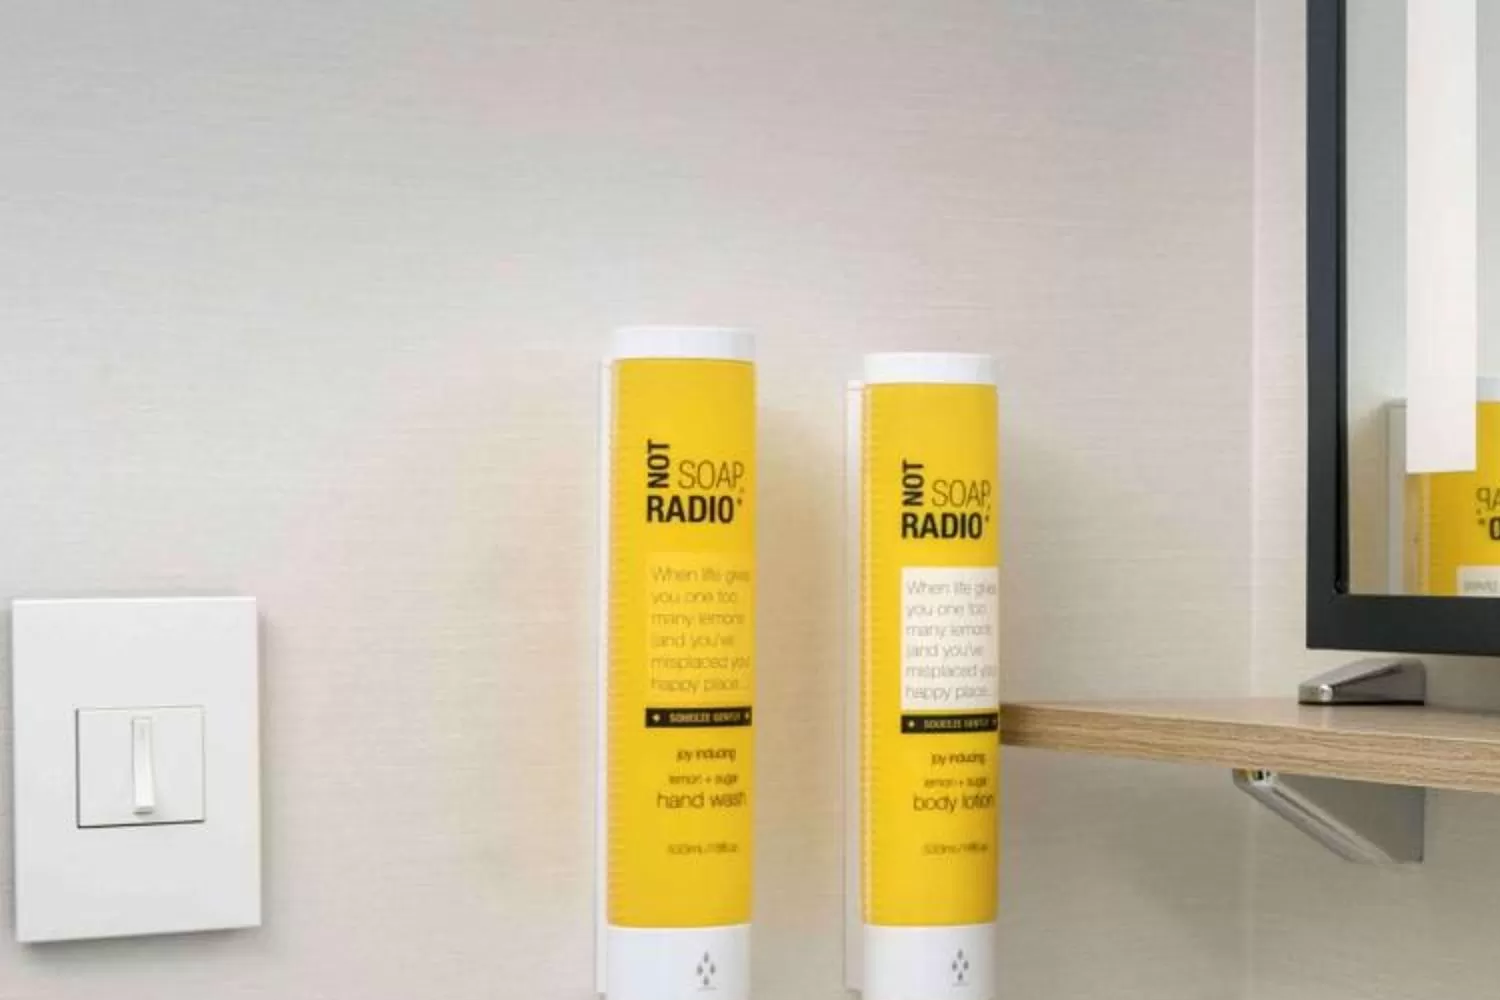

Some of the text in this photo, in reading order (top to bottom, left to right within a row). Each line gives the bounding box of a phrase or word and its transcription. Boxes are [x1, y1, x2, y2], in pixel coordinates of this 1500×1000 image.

[647, 438, 670, 489] NOT
[902, 457, 924, 507] NOT
[651, 566, 698, 583] When
[905, 580, 948, 597] When
[651, 592, 681, 607] you
[685, 592, 714, 605] one
[905, 604, 933, 617] you
[937, 603, 964, 616] one
[651, 614, 696, 629] many
[905, 624, 945, 641] many
[905, 663, 977, 680] misplaced
[651, 677, 697, 696] happy
[905, 685, 950, 702] happy
[930, 751, 946, 767] joy
[656, 791, 747, 809] hand wash
[912, 792, 994, 813] body lotion
